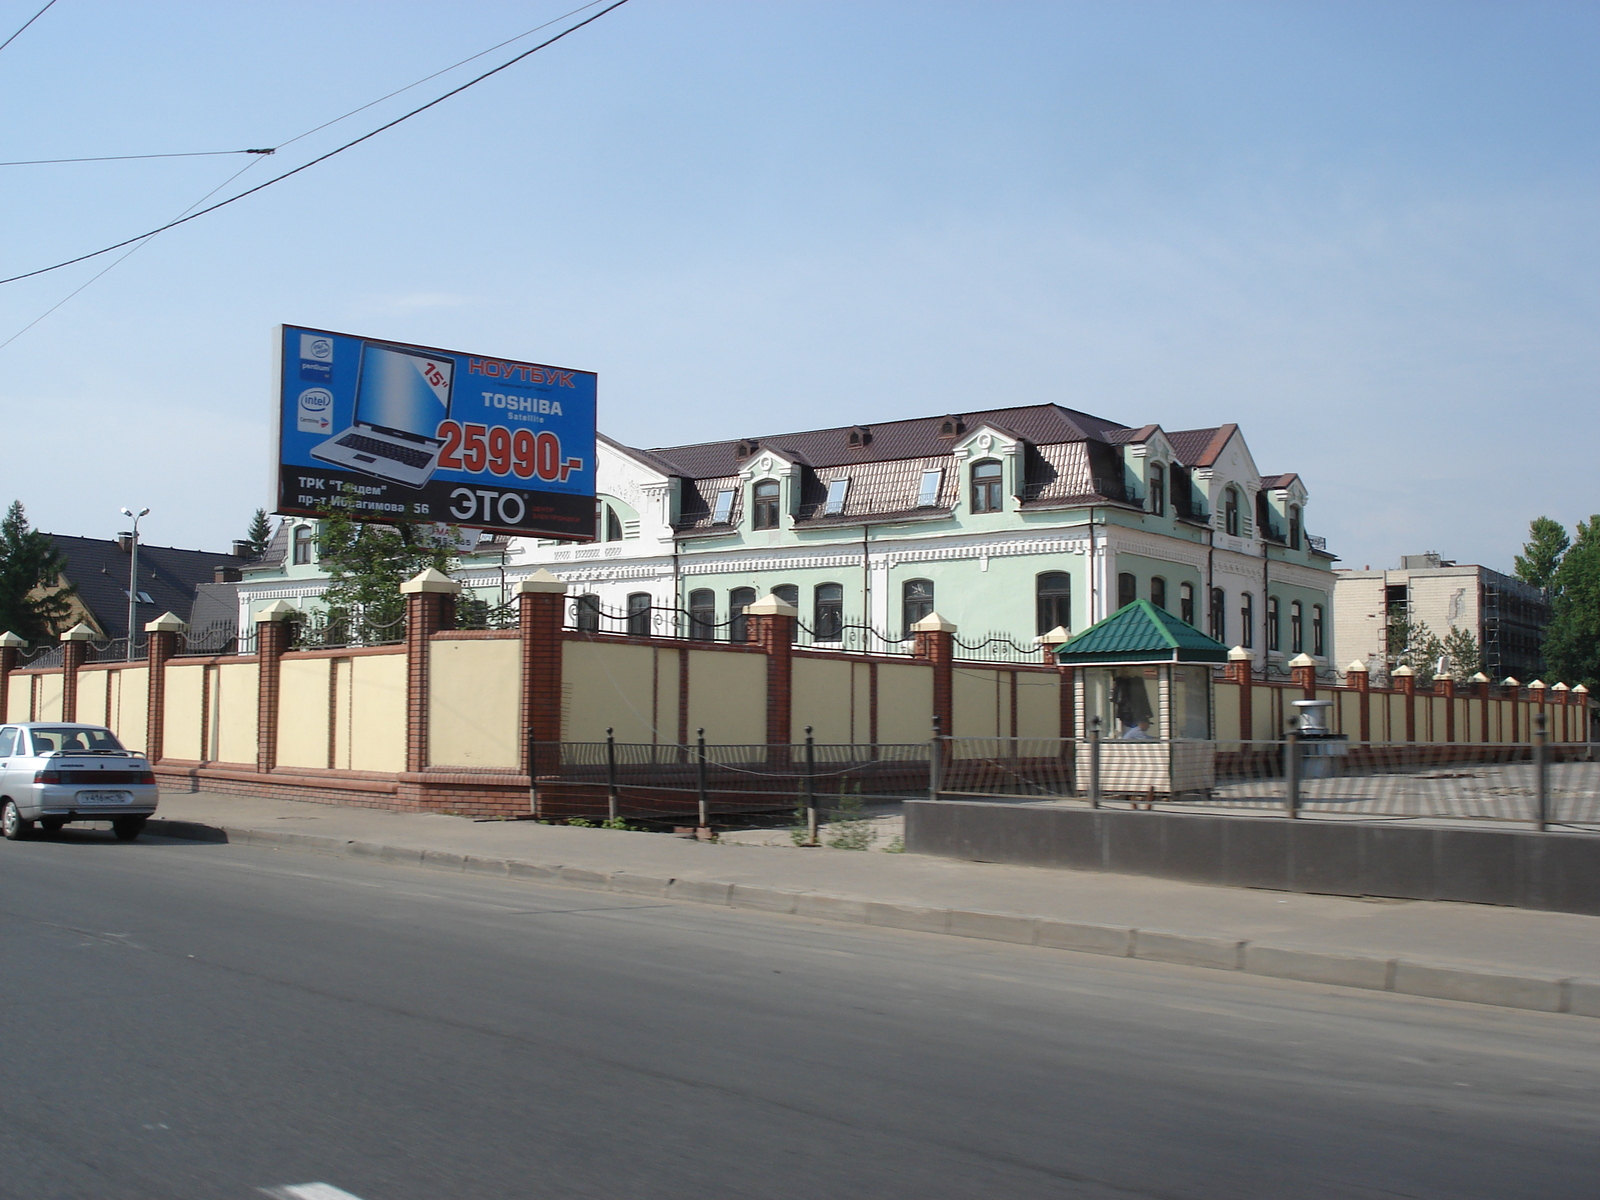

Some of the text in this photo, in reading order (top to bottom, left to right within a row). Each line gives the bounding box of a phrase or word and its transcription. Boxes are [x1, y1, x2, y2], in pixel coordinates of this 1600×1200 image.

[468, 358, 575, 389] НОУТБУК
[304, 394, 326, 407] intel
[481, 391, 563, 416] TOSHIBA
[298, 477, 387, 496] ТРК "Тндем"
[297, 494, 327, 507] пр-т
[449, 487, 526, 525] ЭТО
